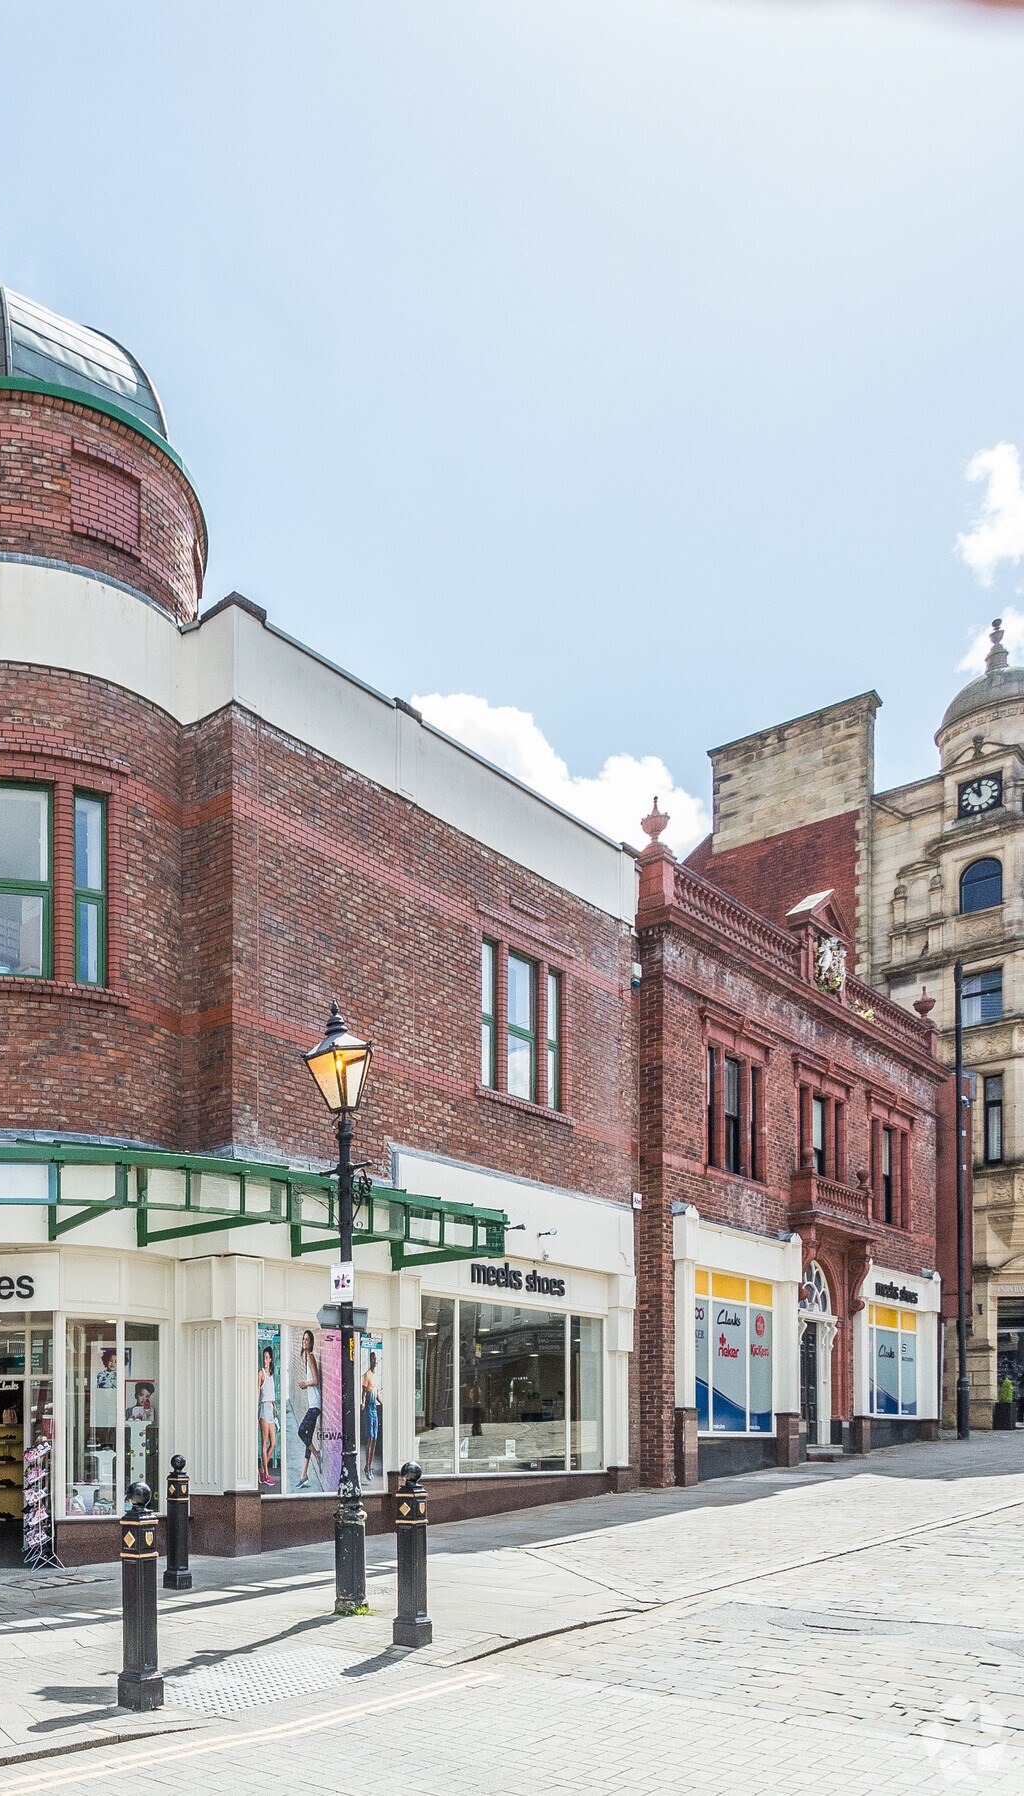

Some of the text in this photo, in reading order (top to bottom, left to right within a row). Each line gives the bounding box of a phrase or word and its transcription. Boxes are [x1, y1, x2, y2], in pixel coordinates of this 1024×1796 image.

[471, 1262, 565, 1297] meeks shoes
[717, 1309, 741, 1326] Clarks
[718, 1344, 740, 1358] rieker
[878, 1344, 896, 1359] Clarks
